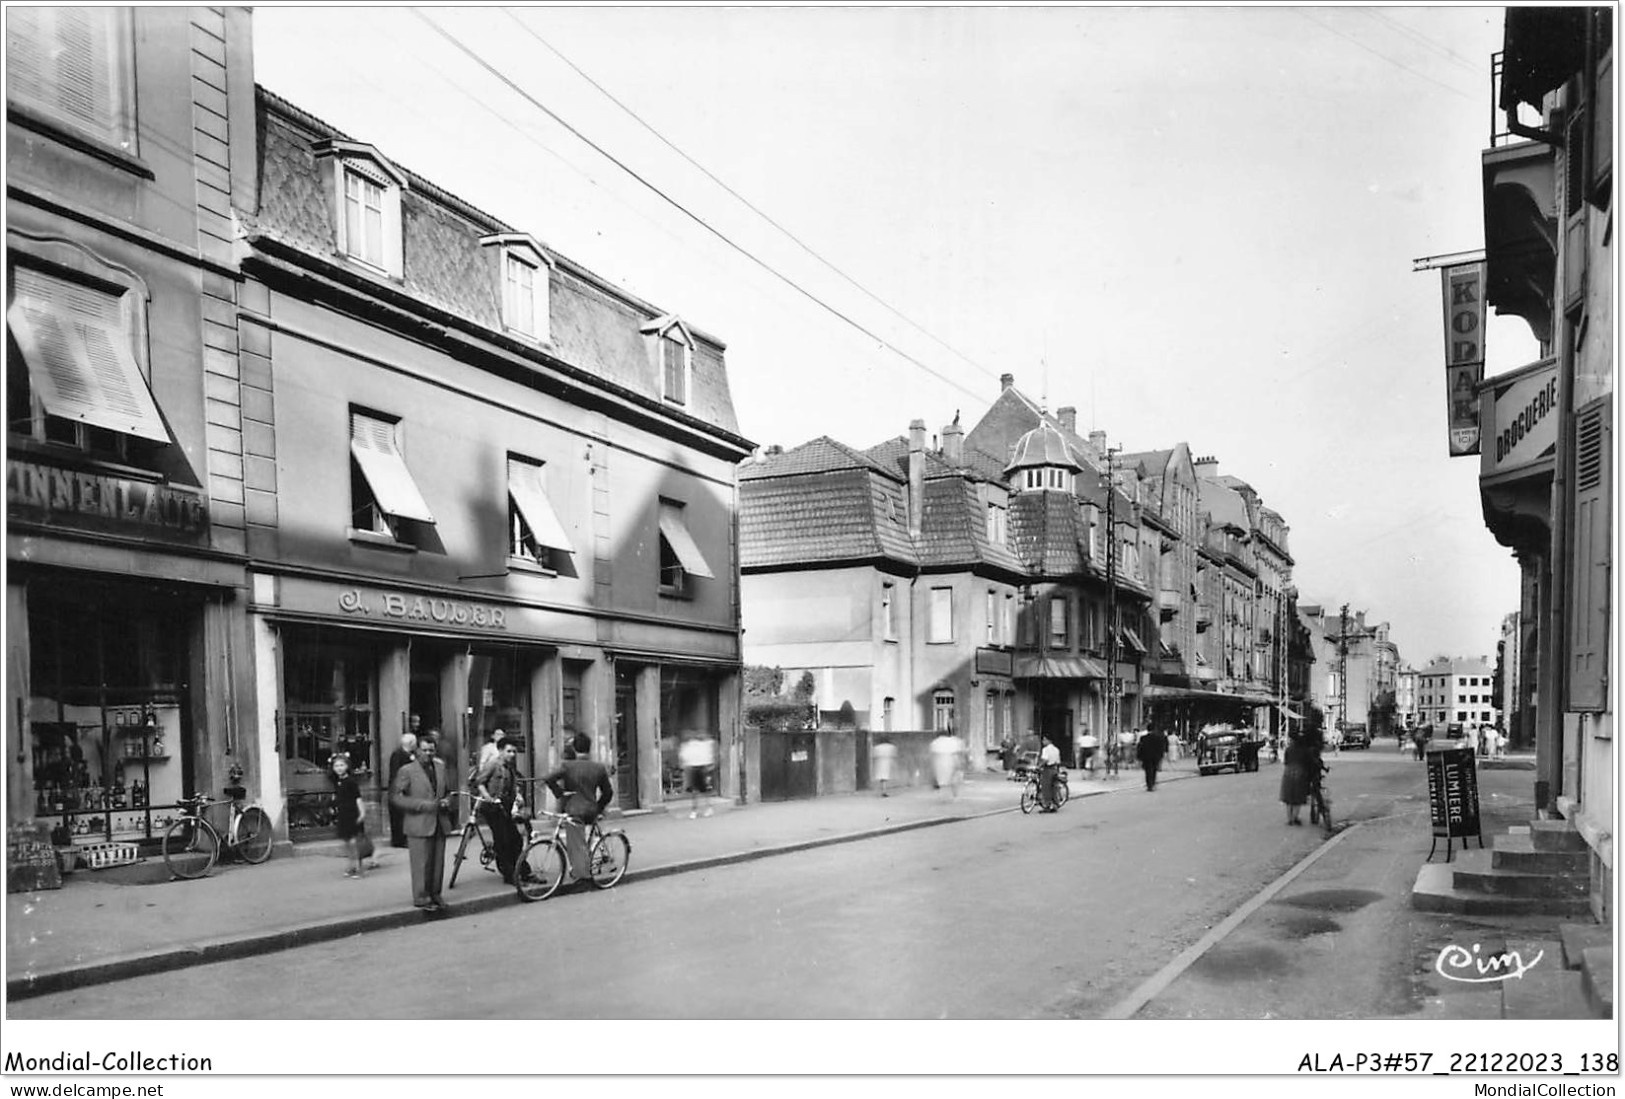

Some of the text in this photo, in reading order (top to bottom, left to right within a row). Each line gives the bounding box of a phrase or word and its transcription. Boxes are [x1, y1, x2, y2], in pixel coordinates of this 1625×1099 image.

[1452, 281, 1479, 420] KODAK
[1496, 376, 1556, 463] DROGUERIE
[339, 588, 506, 629] J. BAULER
[1446, 763, 1462, 823] LUMIERE
